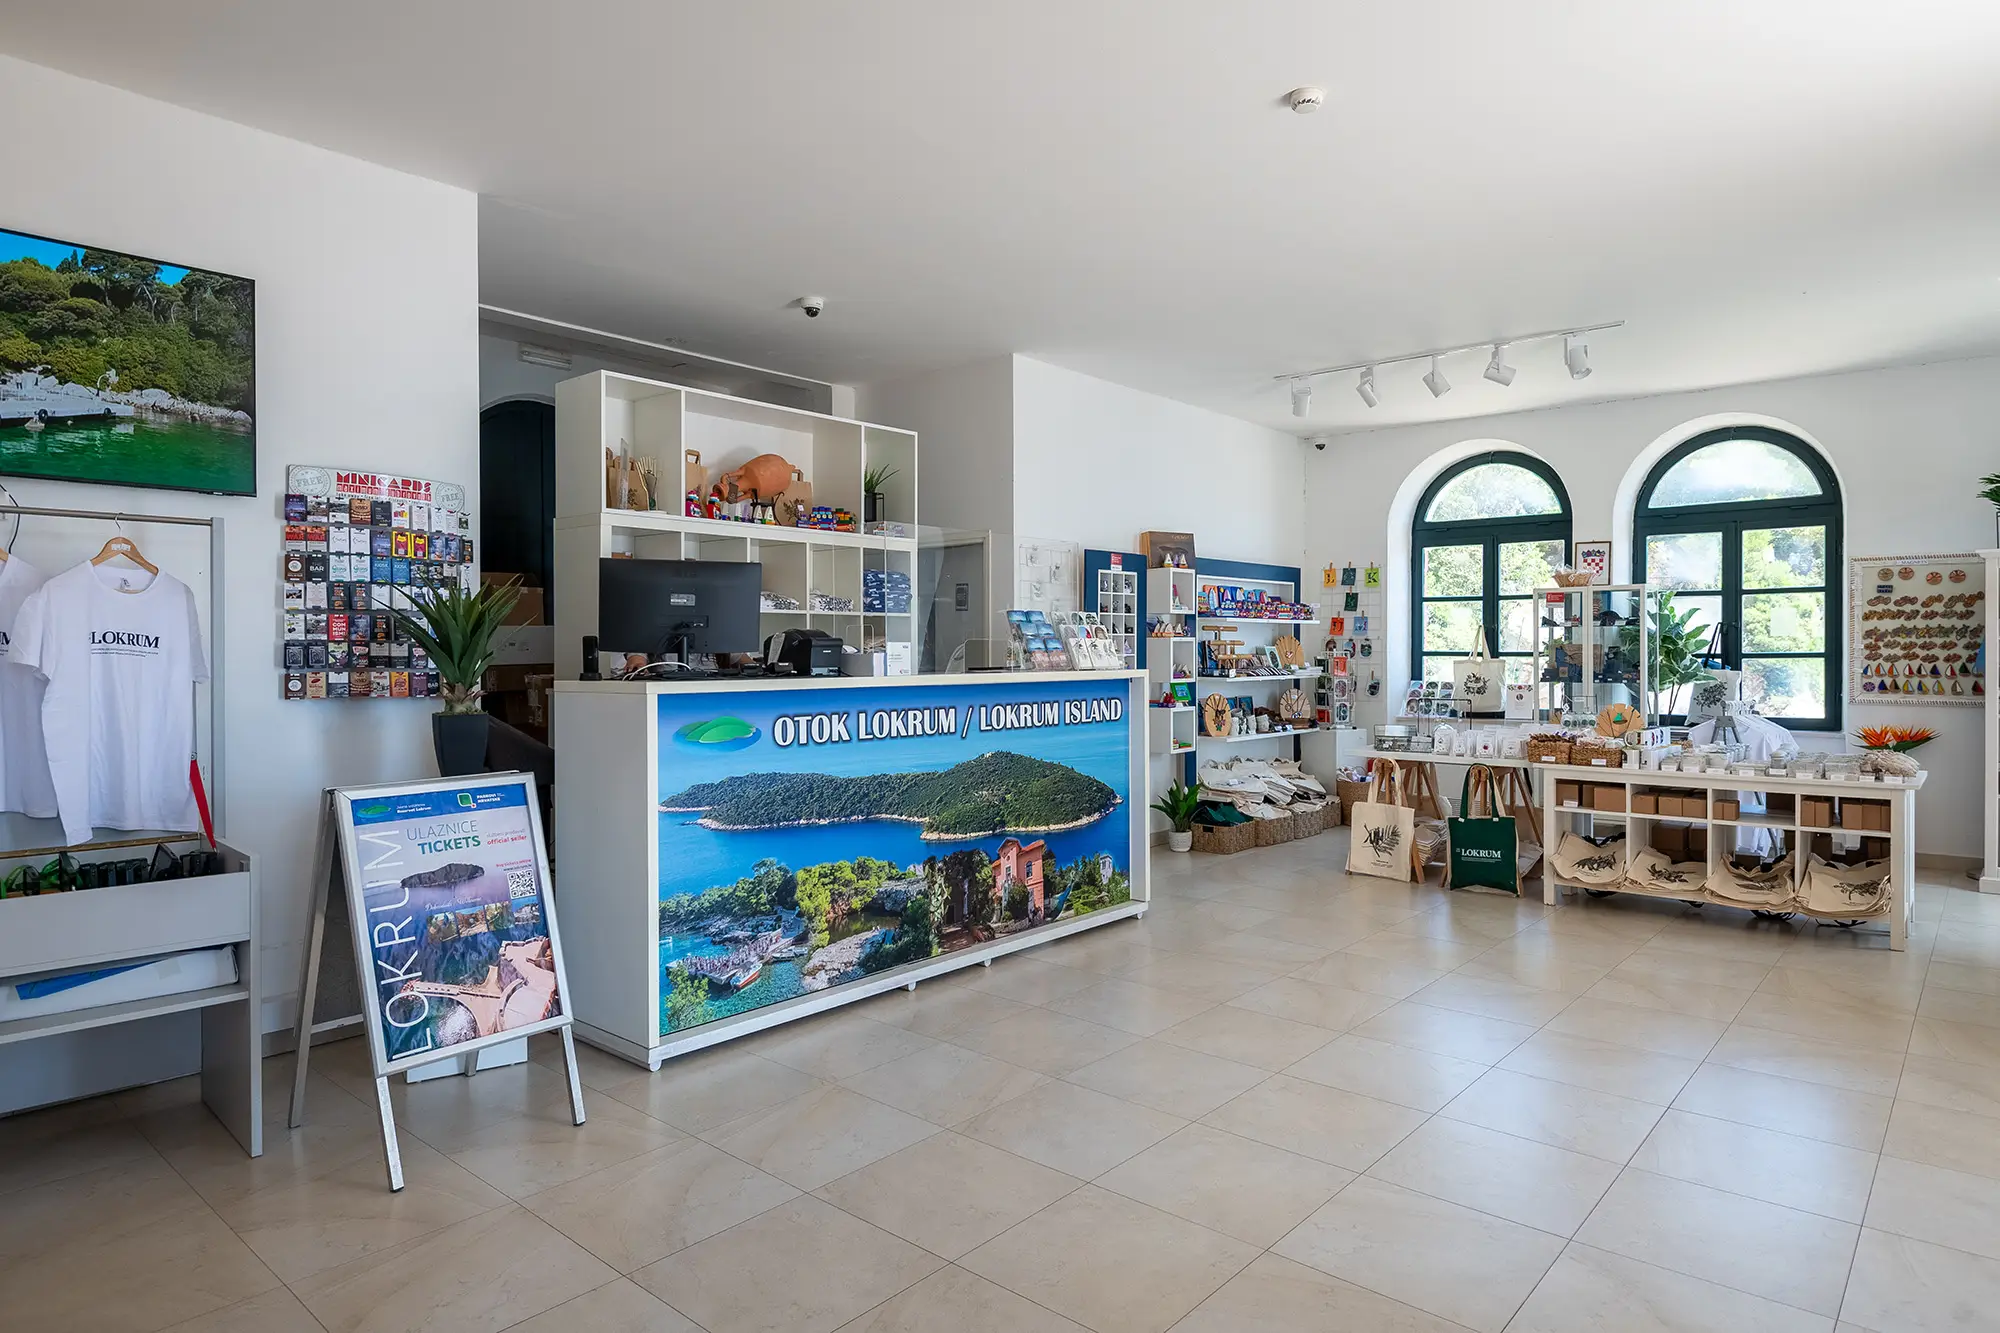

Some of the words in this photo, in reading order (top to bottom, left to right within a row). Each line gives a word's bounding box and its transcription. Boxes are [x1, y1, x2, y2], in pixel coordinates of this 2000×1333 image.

[295, 475, 324, 491] FREE
[336, 471, 432, 493] MINICARDS
[441, 492, 460, 502] FREE
[90, 630, 161, 649] LOKRUM
[773, 712, 851, 748] OTOK
[857, 706, 957, 742] LOKRUM
[962, 706, 974, 739] /
[979, 702, 1060, 733] LOKRUM
[1064, 698, 1123, 724] ISLAND
[406, 819, 478, 841] ULAZNICE
[487, 837, 510, 845] official
[510, 834, 527, 842] seller
[417, 835, 481, 855] TICKETS
[1461, 848, 1501, 859] LOKRUM
[360, 829, 432, 1060] LOKRUM
